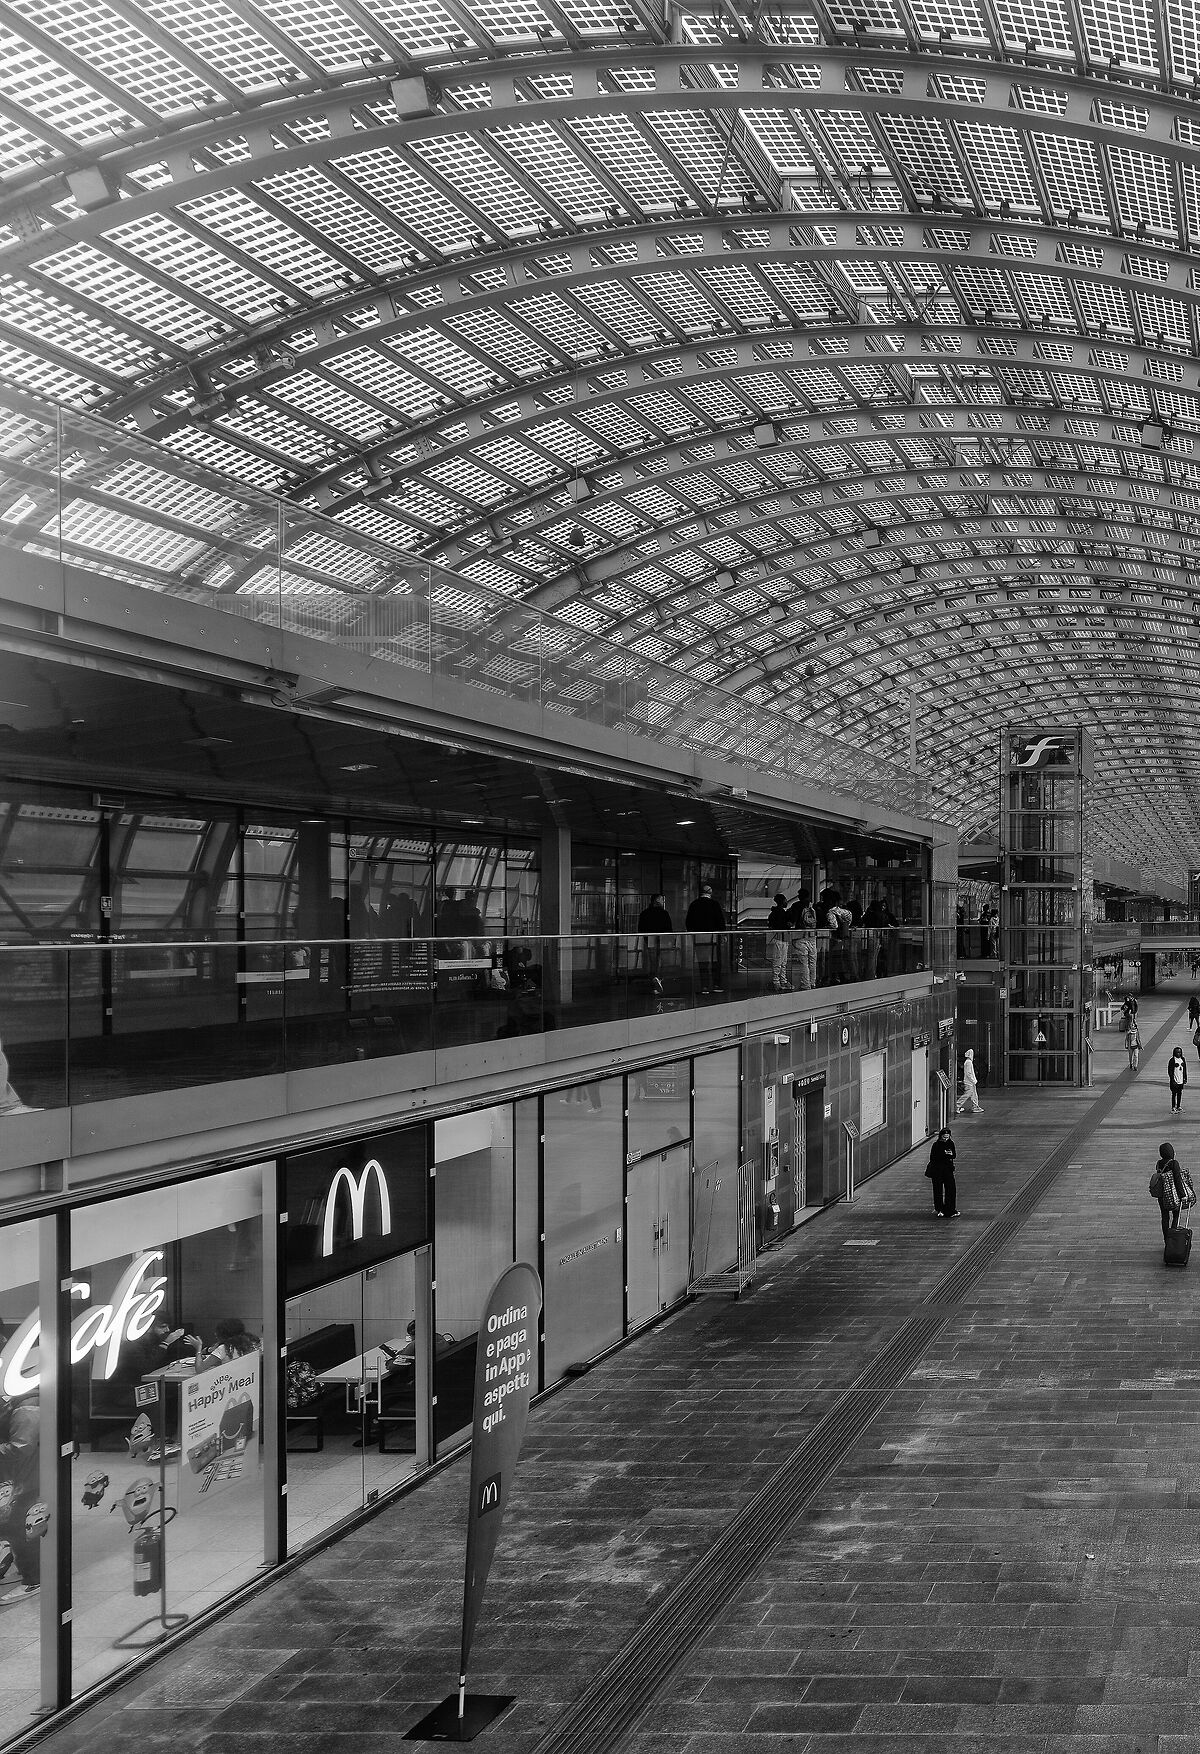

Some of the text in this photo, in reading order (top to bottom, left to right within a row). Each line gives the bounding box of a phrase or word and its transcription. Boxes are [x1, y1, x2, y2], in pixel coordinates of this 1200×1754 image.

[487, 1305, 527, 1333] Ordina
[486, 1328, 527, 1358] e paga
[485, 1363, 498, 1382] in
[498, 1352, 526, 1375] App
[188, 1387, 225, 1412] Happy
[228, 1372, 255, 1394] Meal
[482, 1403, 506, 1433] qui.
